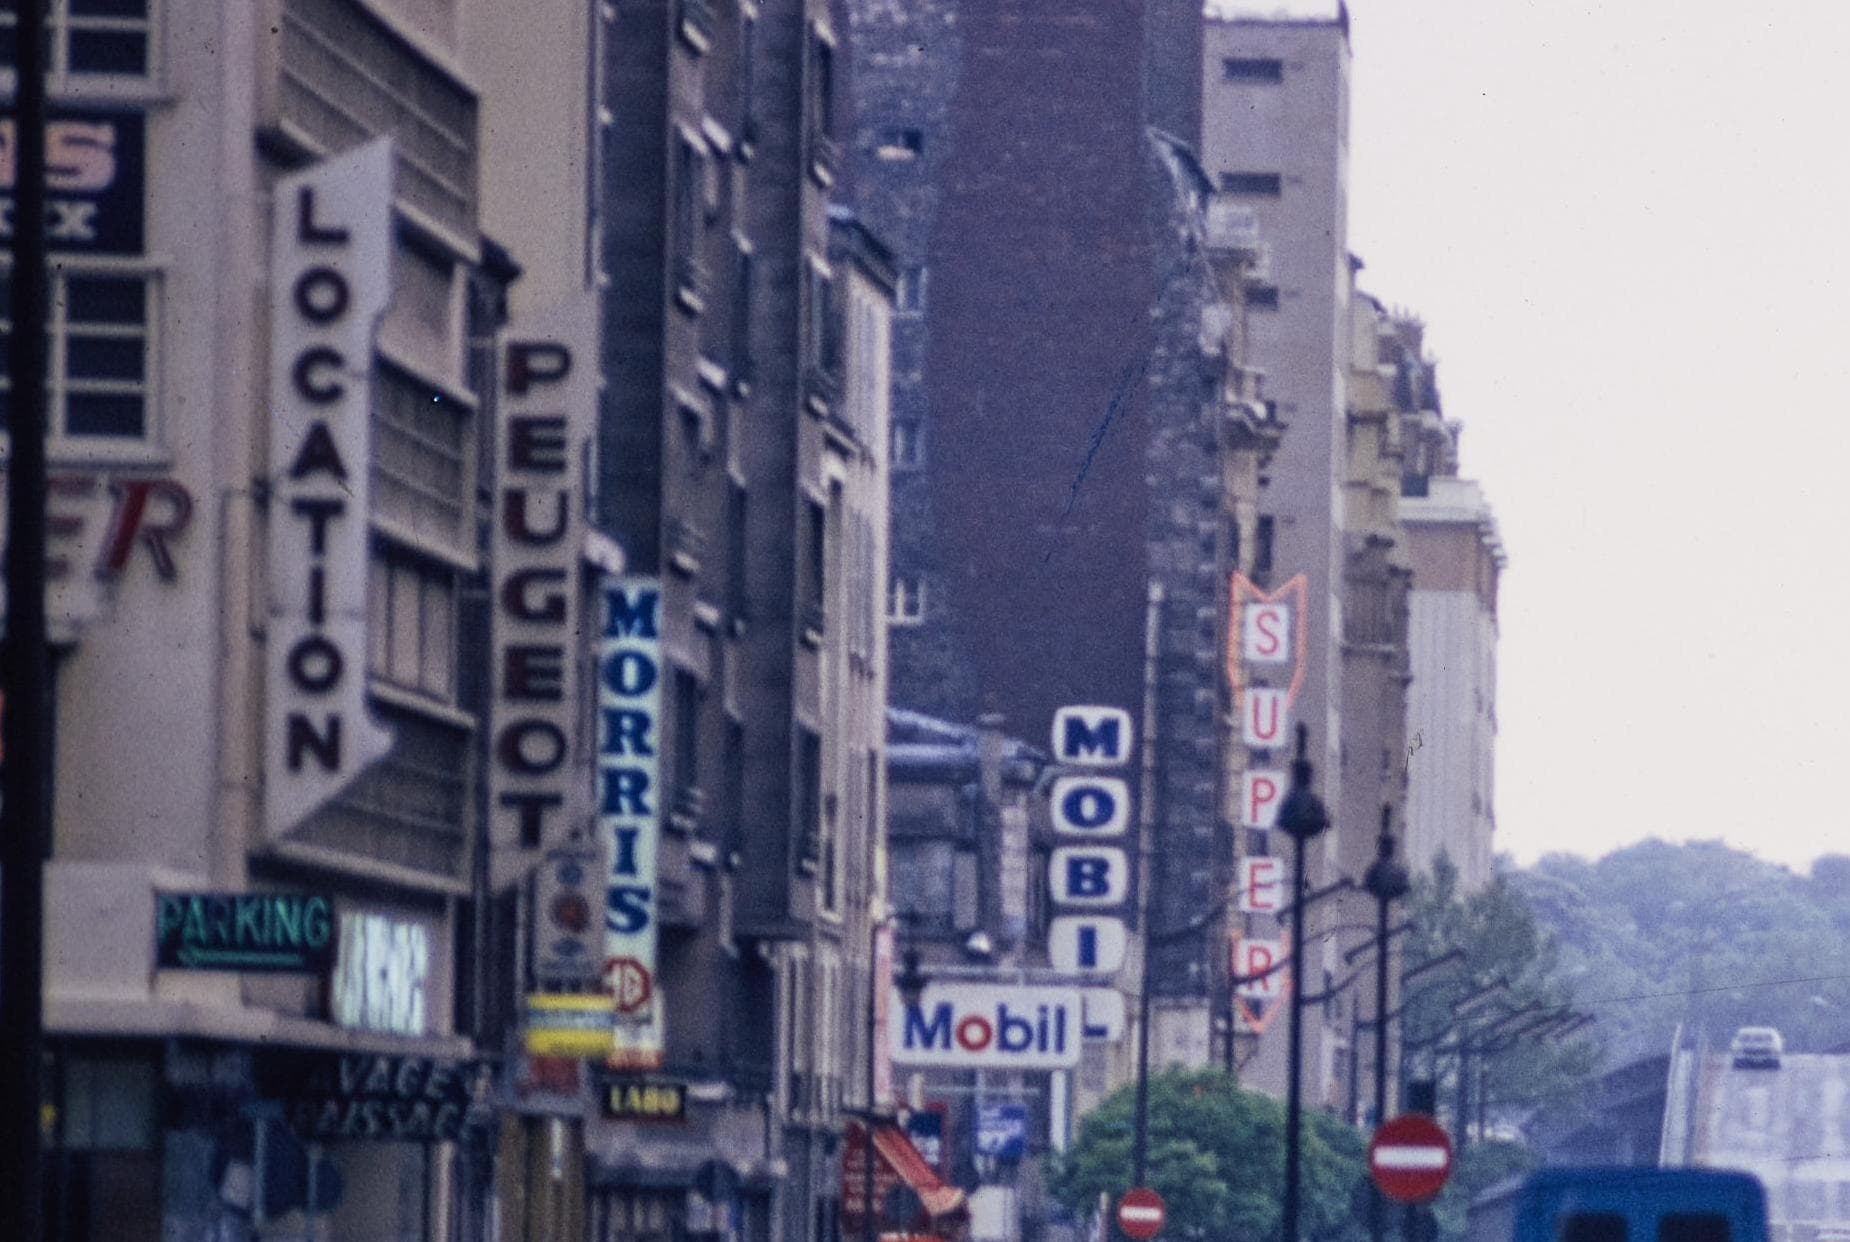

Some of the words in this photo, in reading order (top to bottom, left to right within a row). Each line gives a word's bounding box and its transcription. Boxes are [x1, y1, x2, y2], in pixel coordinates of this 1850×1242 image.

[286, 186, 351, 773] LOCATION
[499, 342, 572, 848] PEUGEOT
[157, 893, 332, 947] PARKING
[604, 587, 661, 933] MORRIS
[1246, 609, 1281, 991] SUPER
[903, 1002, 1067, 1053] Mobil
